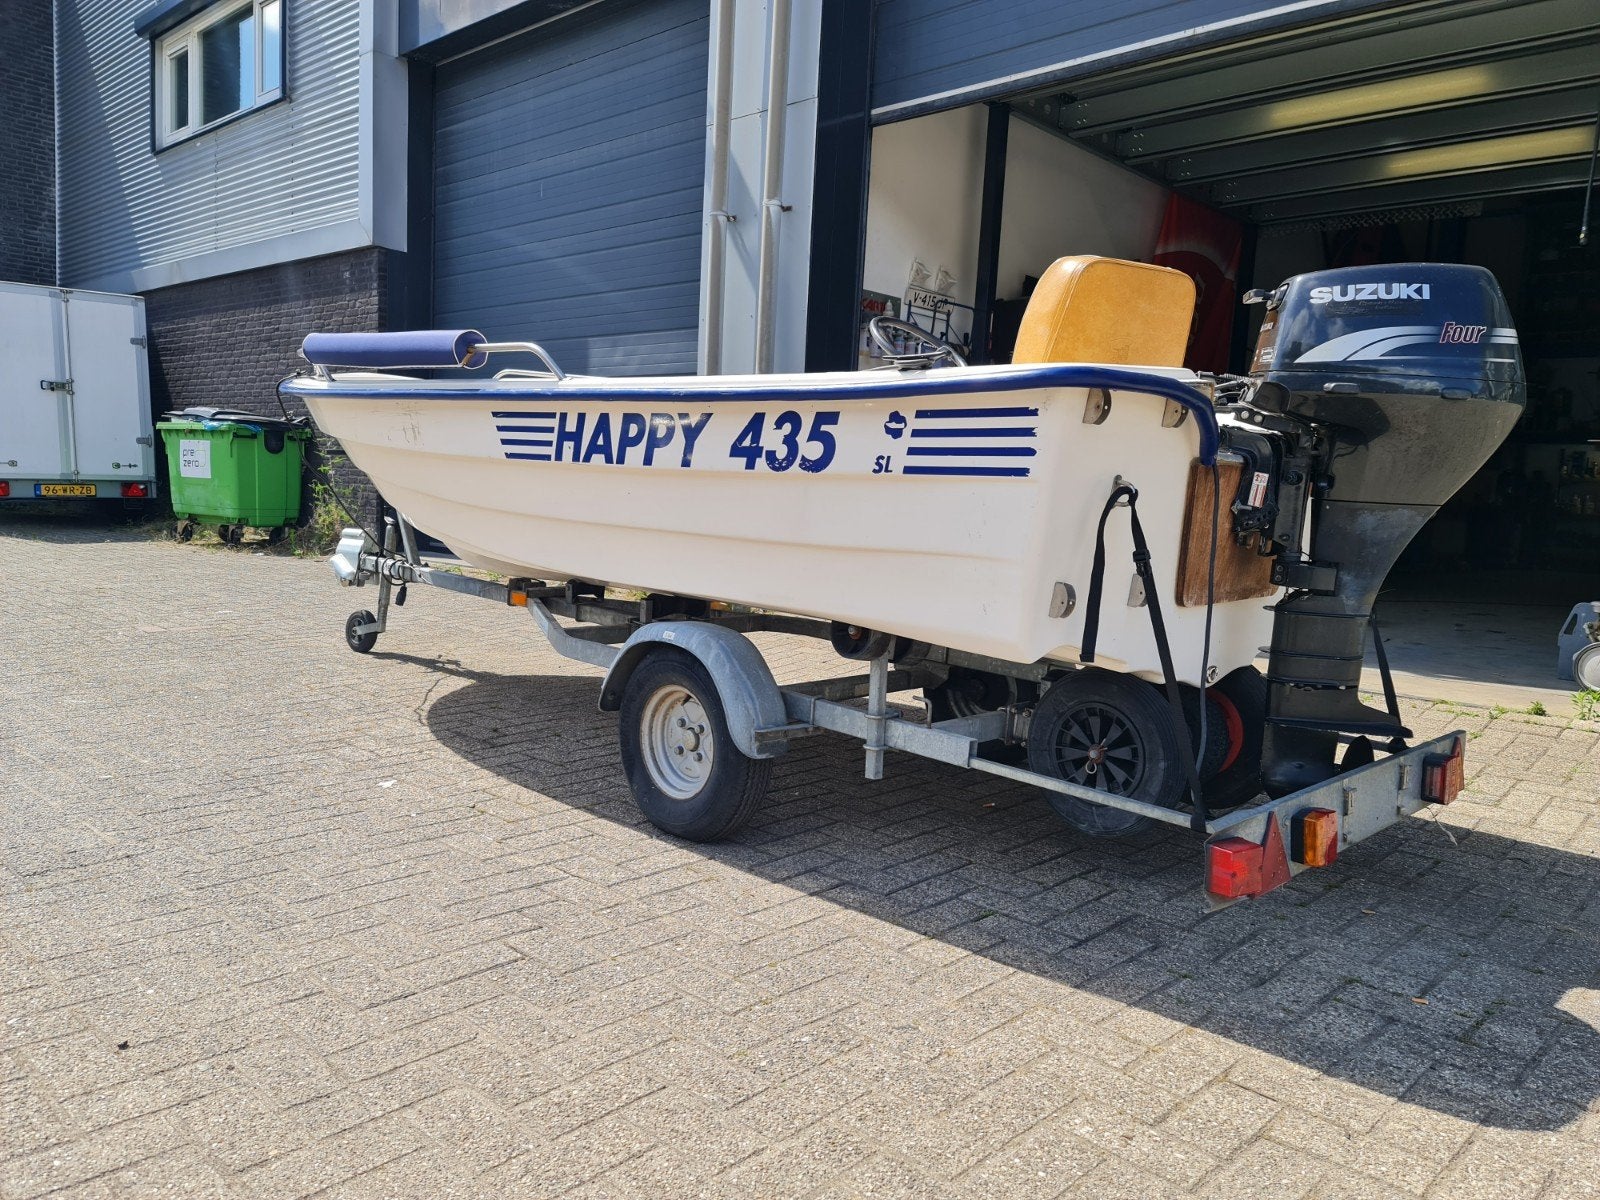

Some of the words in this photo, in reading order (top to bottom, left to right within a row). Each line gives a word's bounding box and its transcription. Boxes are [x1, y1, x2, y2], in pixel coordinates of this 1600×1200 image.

[1309, 282, 1431, 305] SUZUKI
[1439, 321, 1488, 344] Four
[554, 411, 714, 468] HAPPY
[728, 410, 841, 474] 435
[872, 454, 893, 474] SL
[44, 485, 93, 495] 96-WR-ZB
